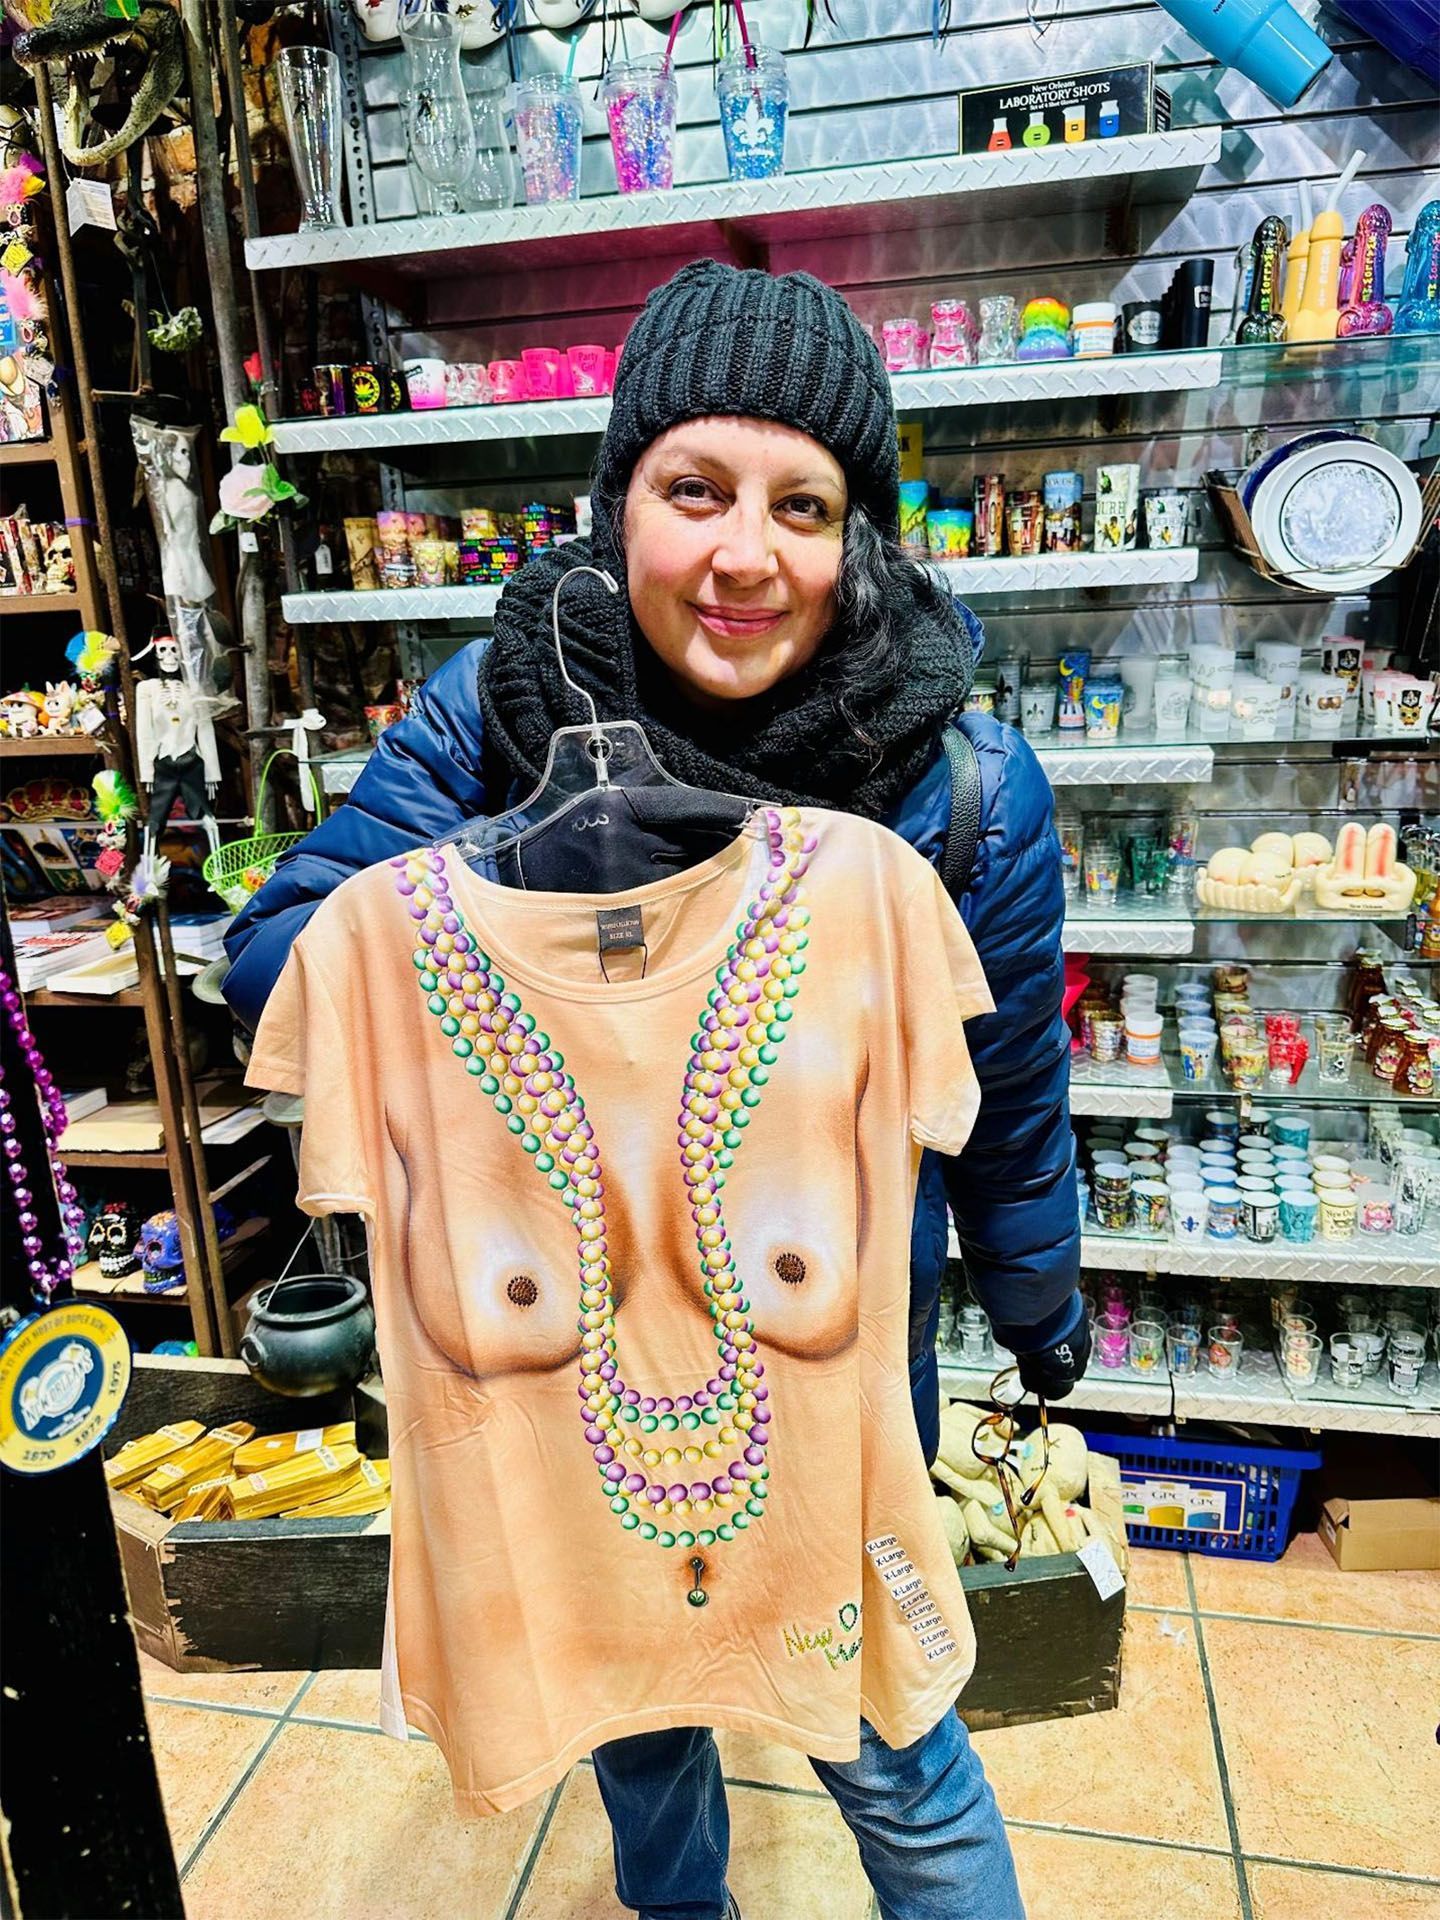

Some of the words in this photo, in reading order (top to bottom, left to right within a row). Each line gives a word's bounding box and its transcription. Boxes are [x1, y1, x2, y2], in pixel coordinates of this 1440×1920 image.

[998, 88, 1072, 110] LABORATORY
[1072, 81, 1111, 98] SHOTS
[1031, 85, 1048, 94] New
[1048, 80, 1076, 91] Orleans
[1362, 235, 1377, 284] SWALLOW
[1261, 246, 1274, 295] SWALLOW
[1260, 297, 1270, 312] ME
[578, 352, 598, 362] Party
[1152, 1491, 1177, 1500] GPC
[1190, 1498, 1214, 1506] GPC
[867, 1536, 897, 1552] X-Large
[875, 1549, 906, 1566] X-Large
[883, 1562, 914, 1581] X-Large
[892, 1578, 922, 1597] X-Large
[900, 1590, 929, 1610] X-Large
[906, 1602, 936, 1620] X-Large
[912, 1615, 943, 1632] X-Large
[782, 1623, 833, 1658] New
[919, 1628, 950, 1646] X-Large
[926, 1641, 957, 1661] X-Large
